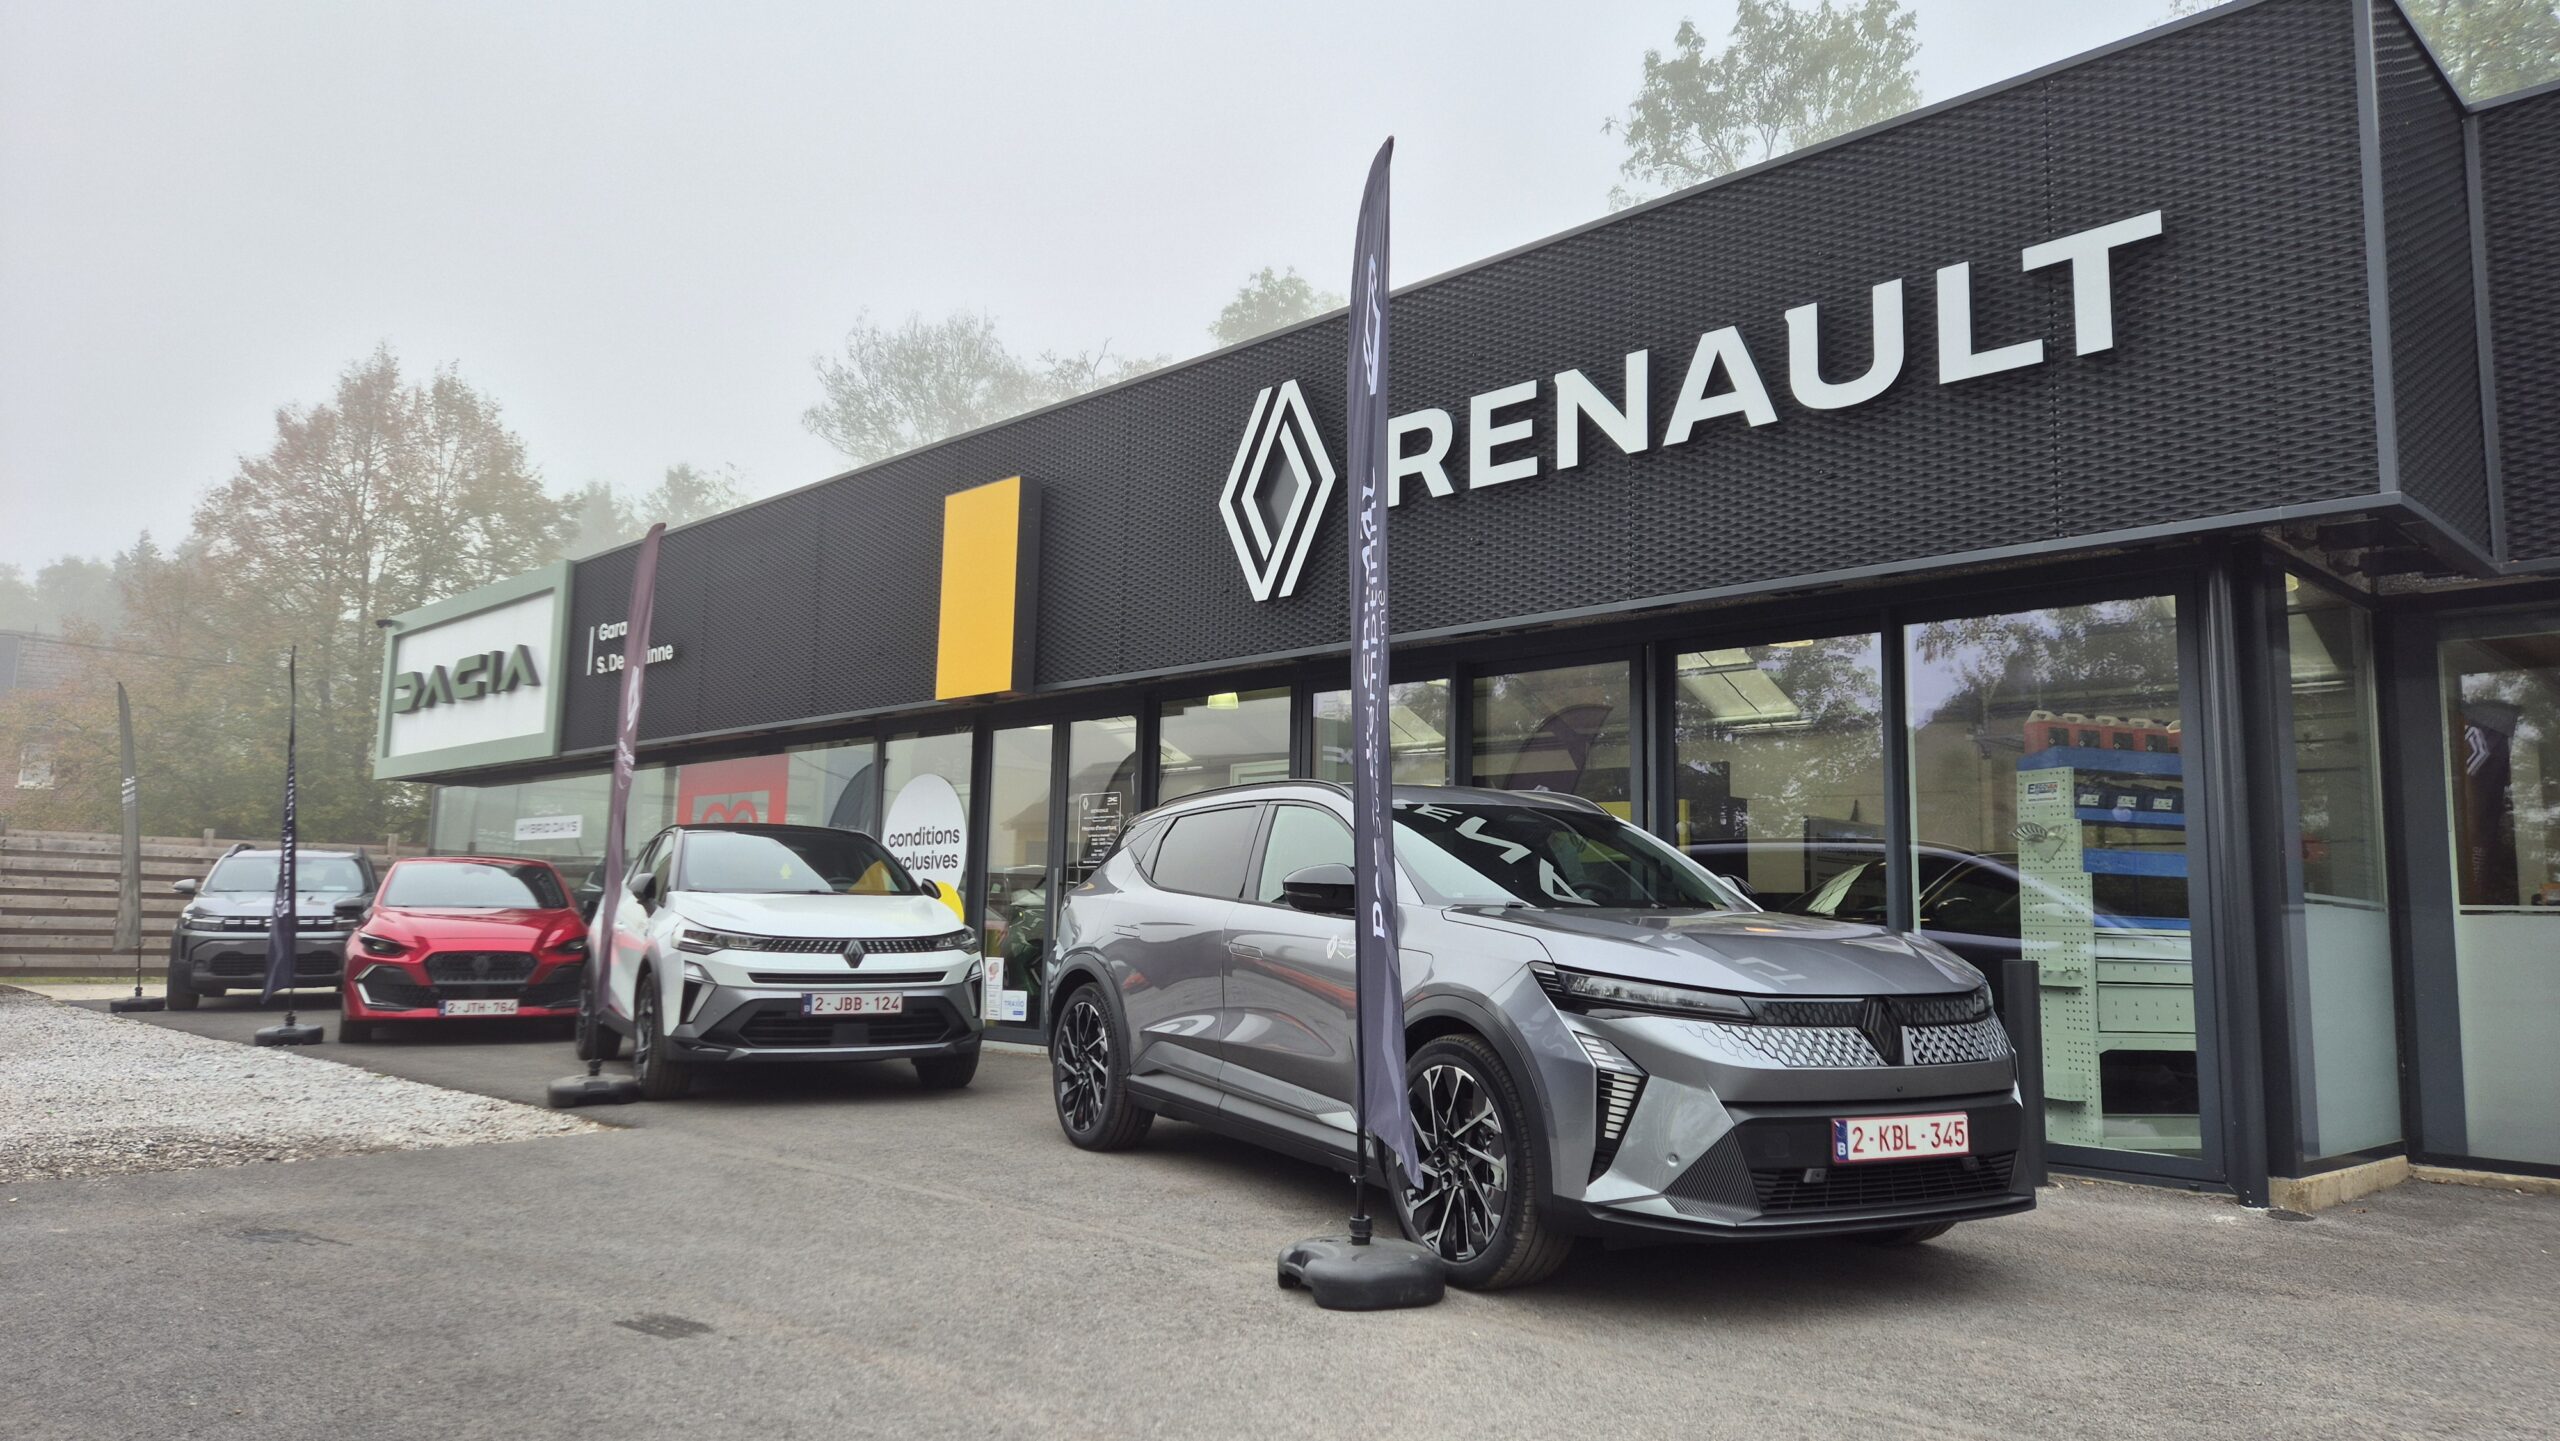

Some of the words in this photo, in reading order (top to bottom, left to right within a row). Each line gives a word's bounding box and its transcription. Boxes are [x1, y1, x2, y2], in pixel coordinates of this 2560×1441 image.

[1388, 209, 2163, 508] RENAULT
[599, 621, 628, 641] Gara
[392, 644, 541, 713] DACIA
[889, 826, 960, 848] conditions
[895, 850, 958, 871] xclusives
[1837, 1143, 1847, 1155] B
